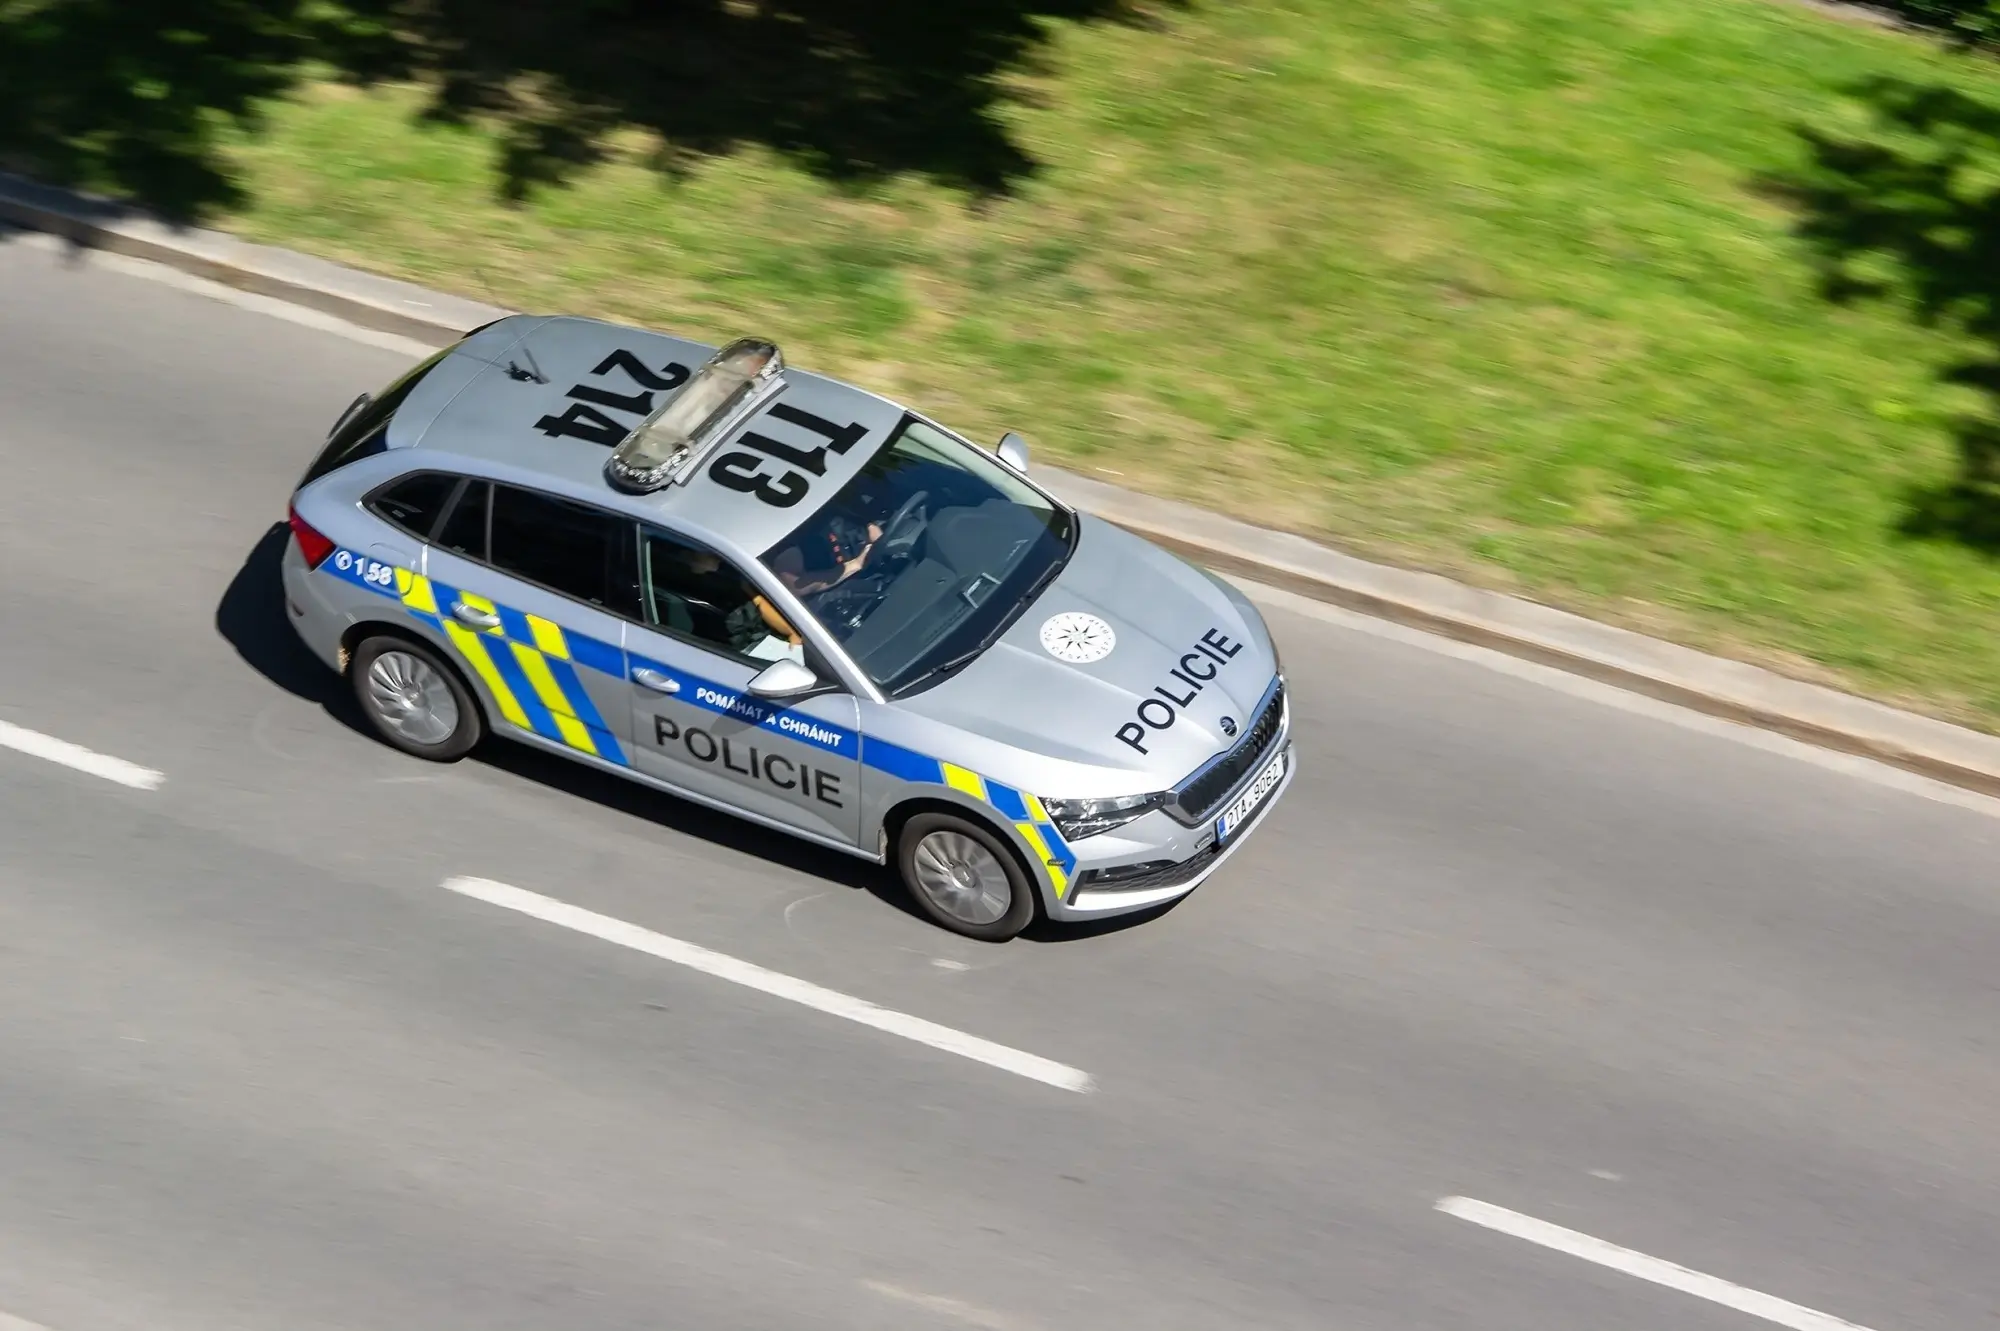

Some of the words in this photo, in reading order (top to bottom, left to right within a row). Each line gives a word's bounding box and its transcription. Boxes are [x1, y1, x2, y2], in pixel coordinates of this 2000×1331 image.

[533, 349, 690, 448] 214
[708, 402, 870, 508] T13
[354, 557, 392, 586] 158
[696, 687, 764, 720] POMÁHAT
[765, 712, 777, 726] A
[779, 716, 843, 747] CHRÁNIT
[1114, 627, 1243, 756] POLICIE
[654, 714, 844, 808] POLICIE
[1227, 799, 1247, 830] 2TA
[1253, 763, 1278, 801] 9062
